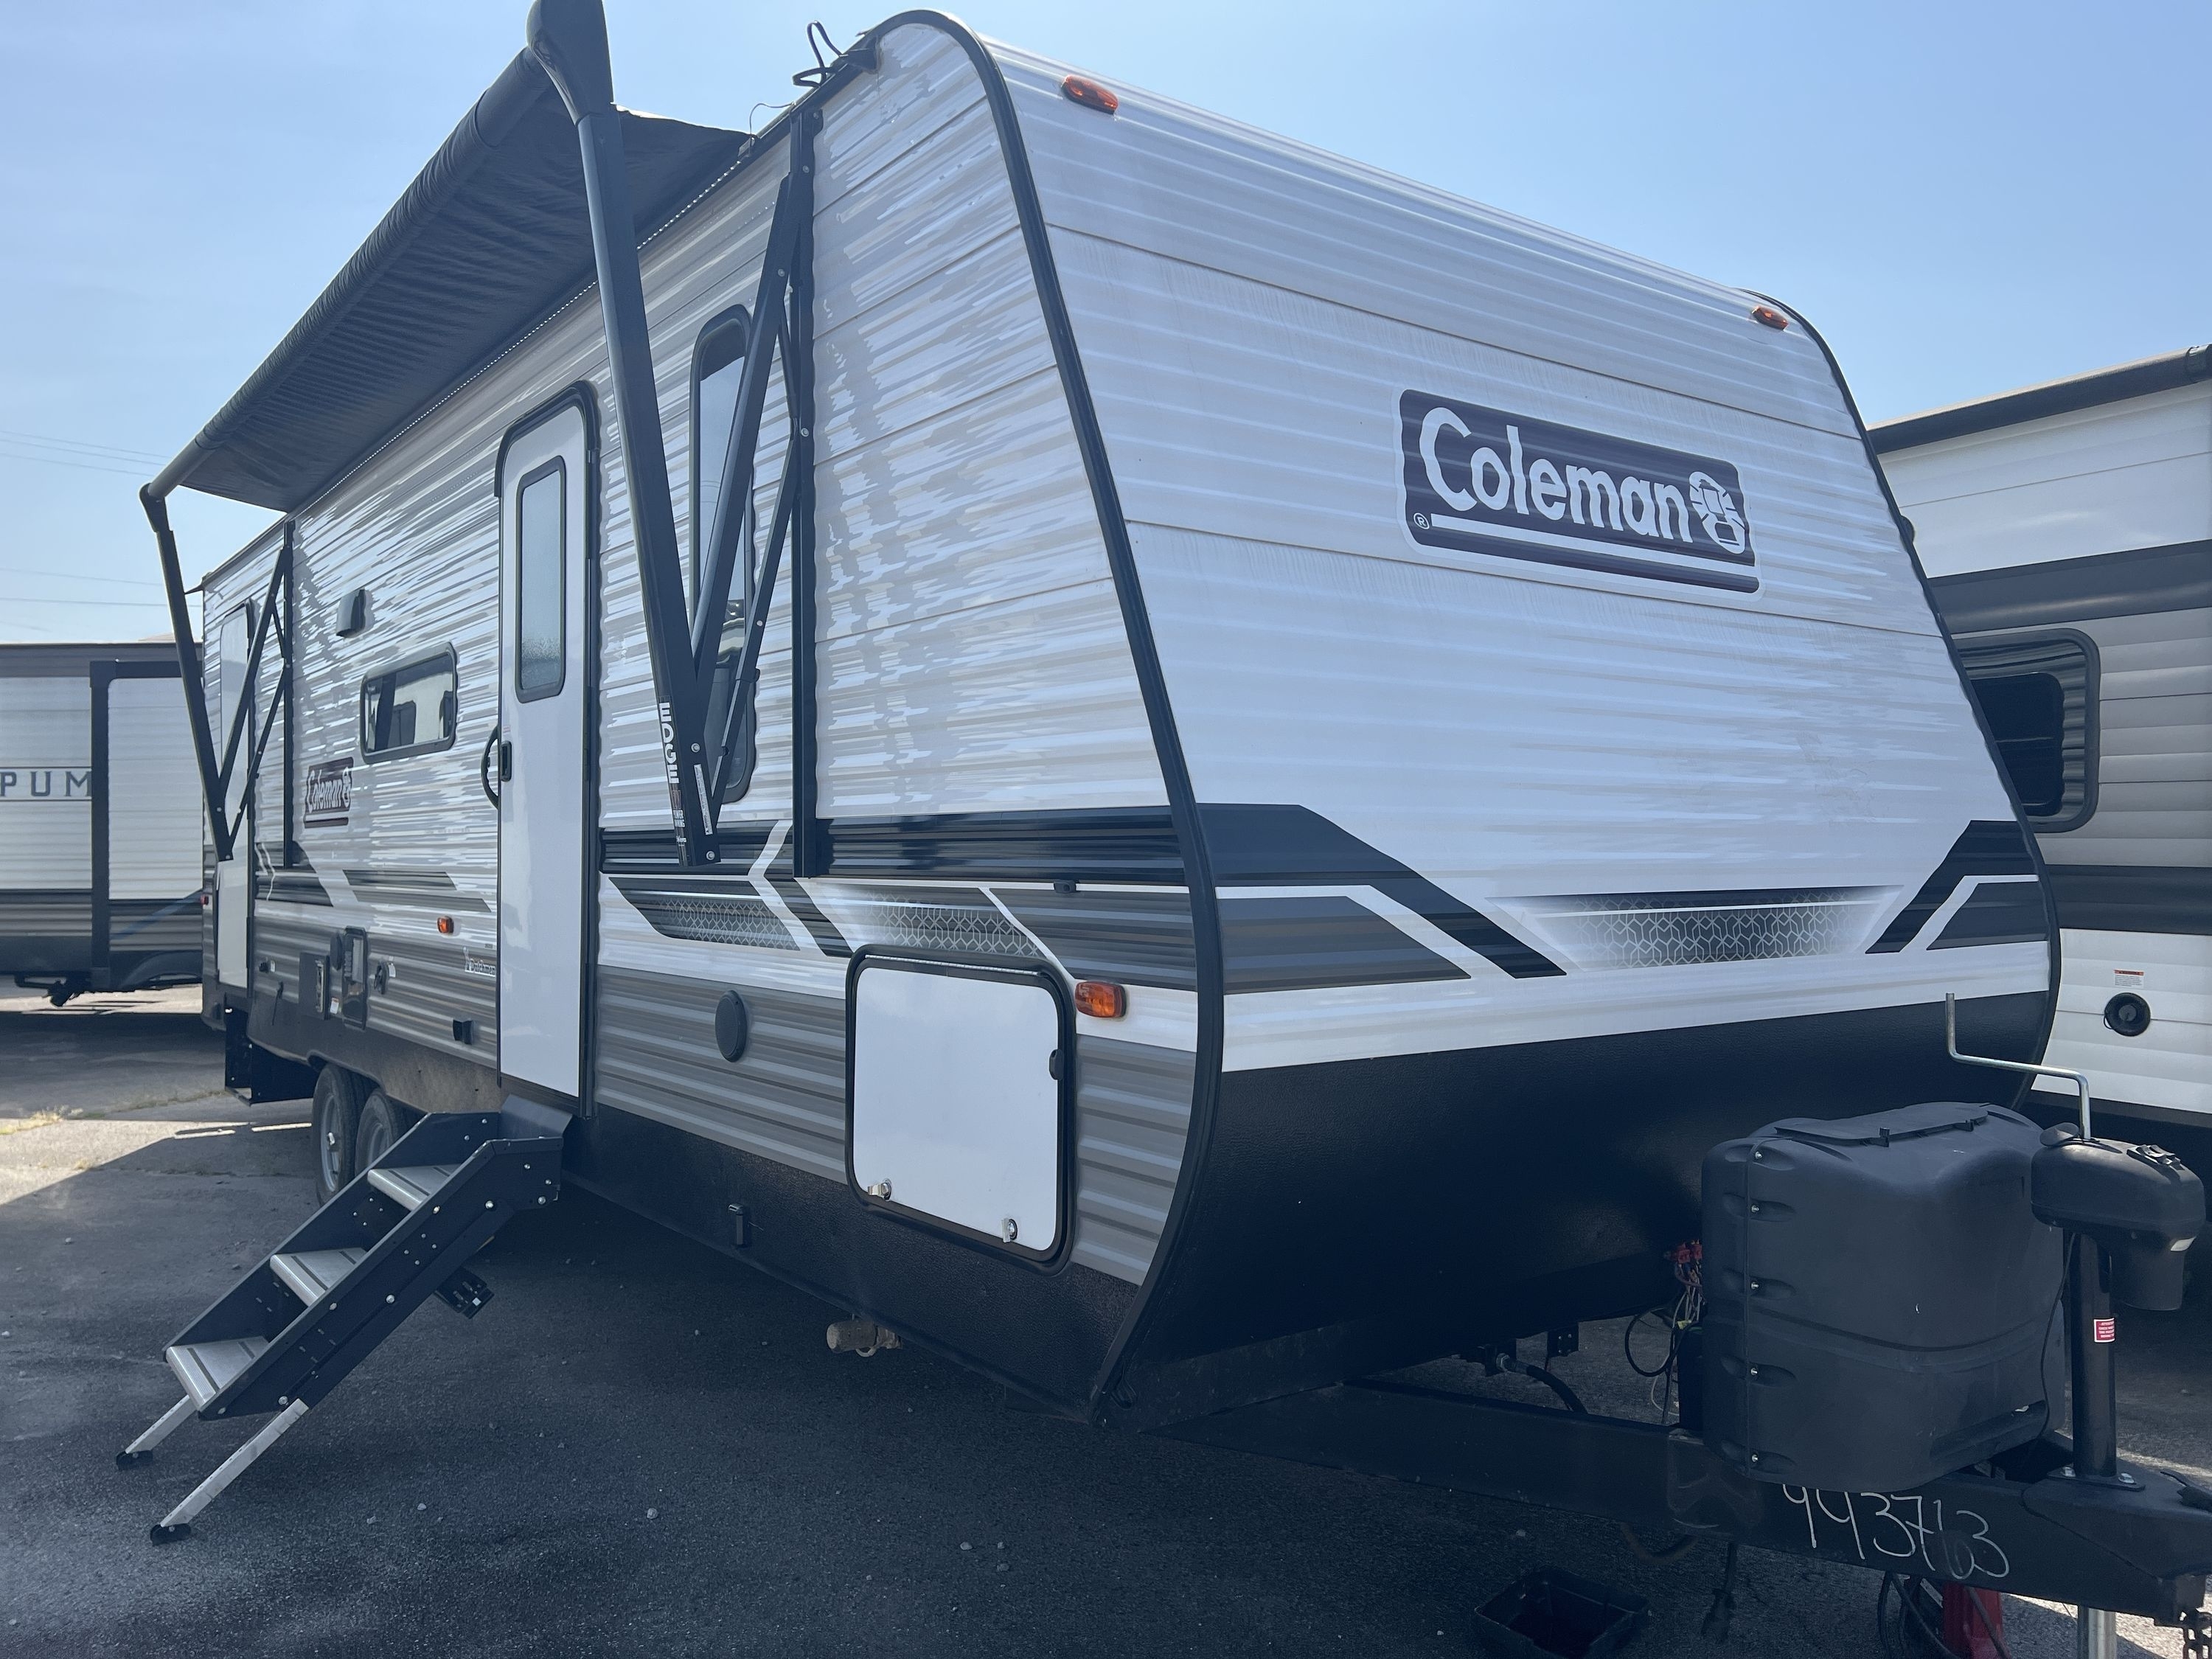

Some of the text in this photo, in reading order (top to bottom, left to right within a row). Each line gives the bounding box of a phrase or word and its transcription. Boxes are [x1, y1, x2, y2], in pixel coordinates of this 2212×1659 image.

[1419, 407, 1693, 543] Coleman
[658, 702, 680, 784] EDGE
[0, 771, 92, 797] PUM
[307, 770, 343, 813] Coleman
